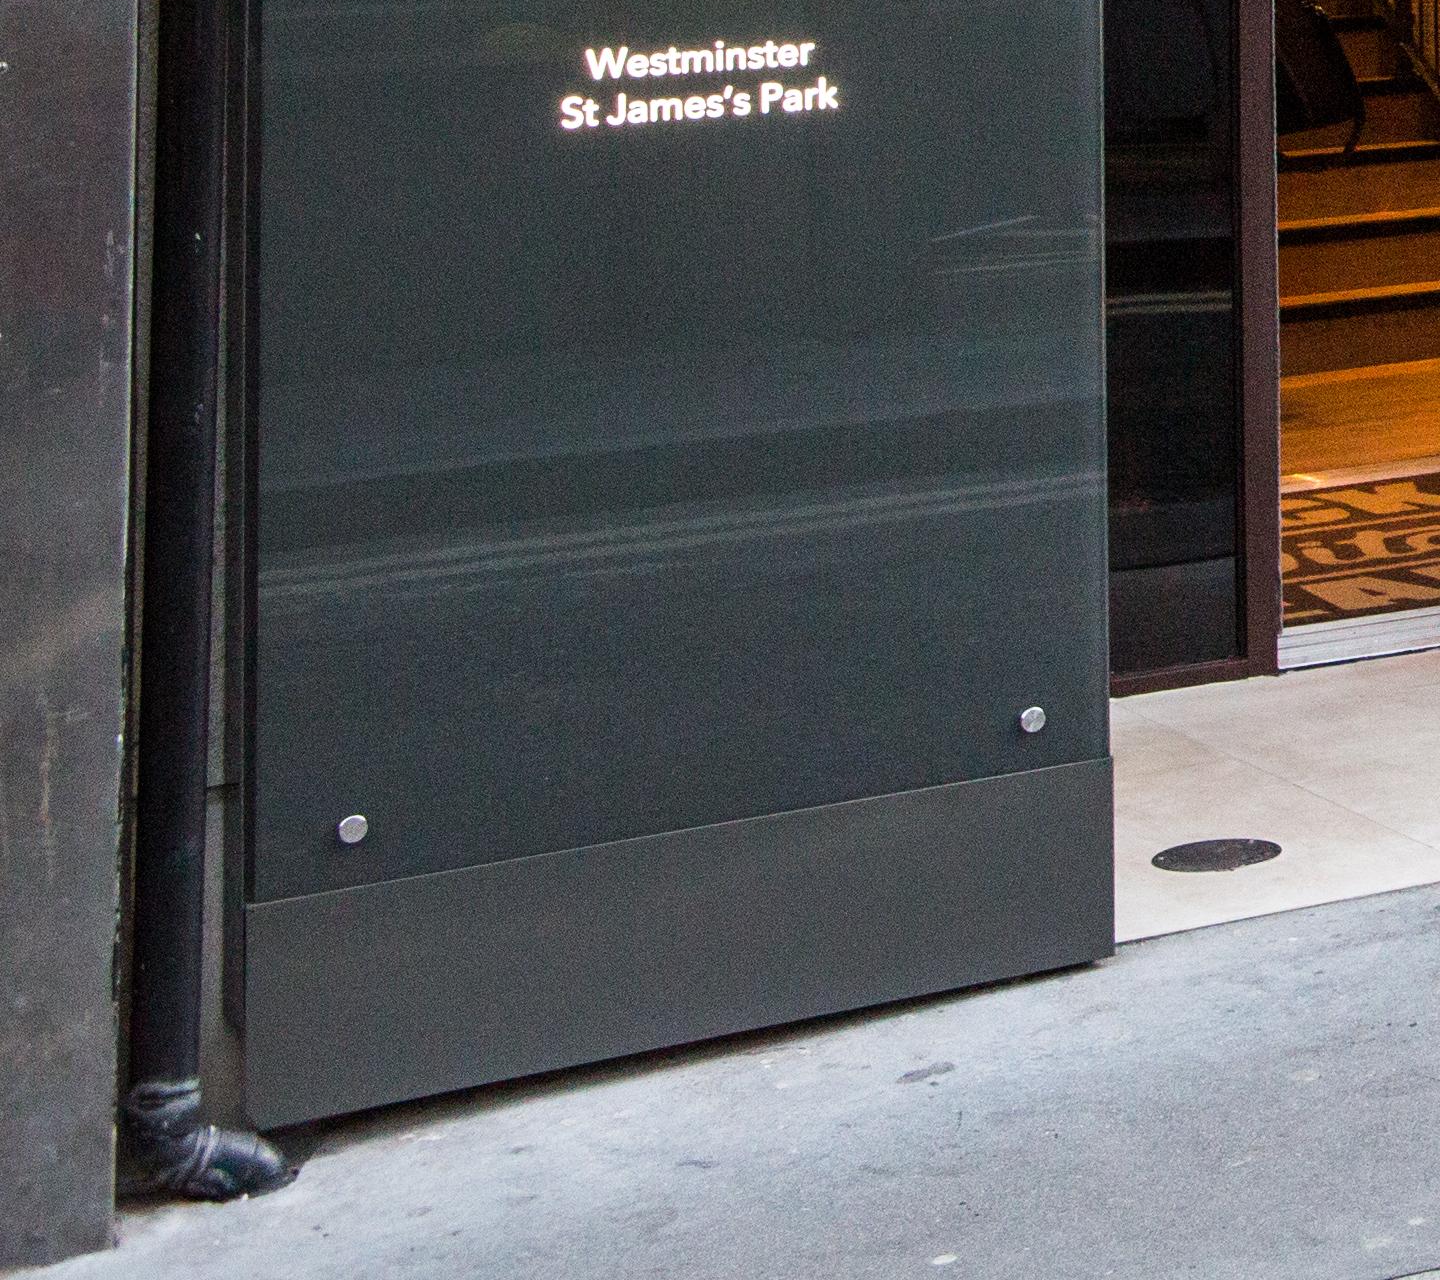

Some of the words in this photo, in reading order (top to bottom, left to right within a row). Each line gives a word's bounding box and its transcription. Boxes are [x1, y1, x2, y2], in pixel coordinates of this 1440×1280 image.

[585, 39, 817, 81] Westminster
[560, 94, 604, 130] St
[759, 77, 840, 115] Park
